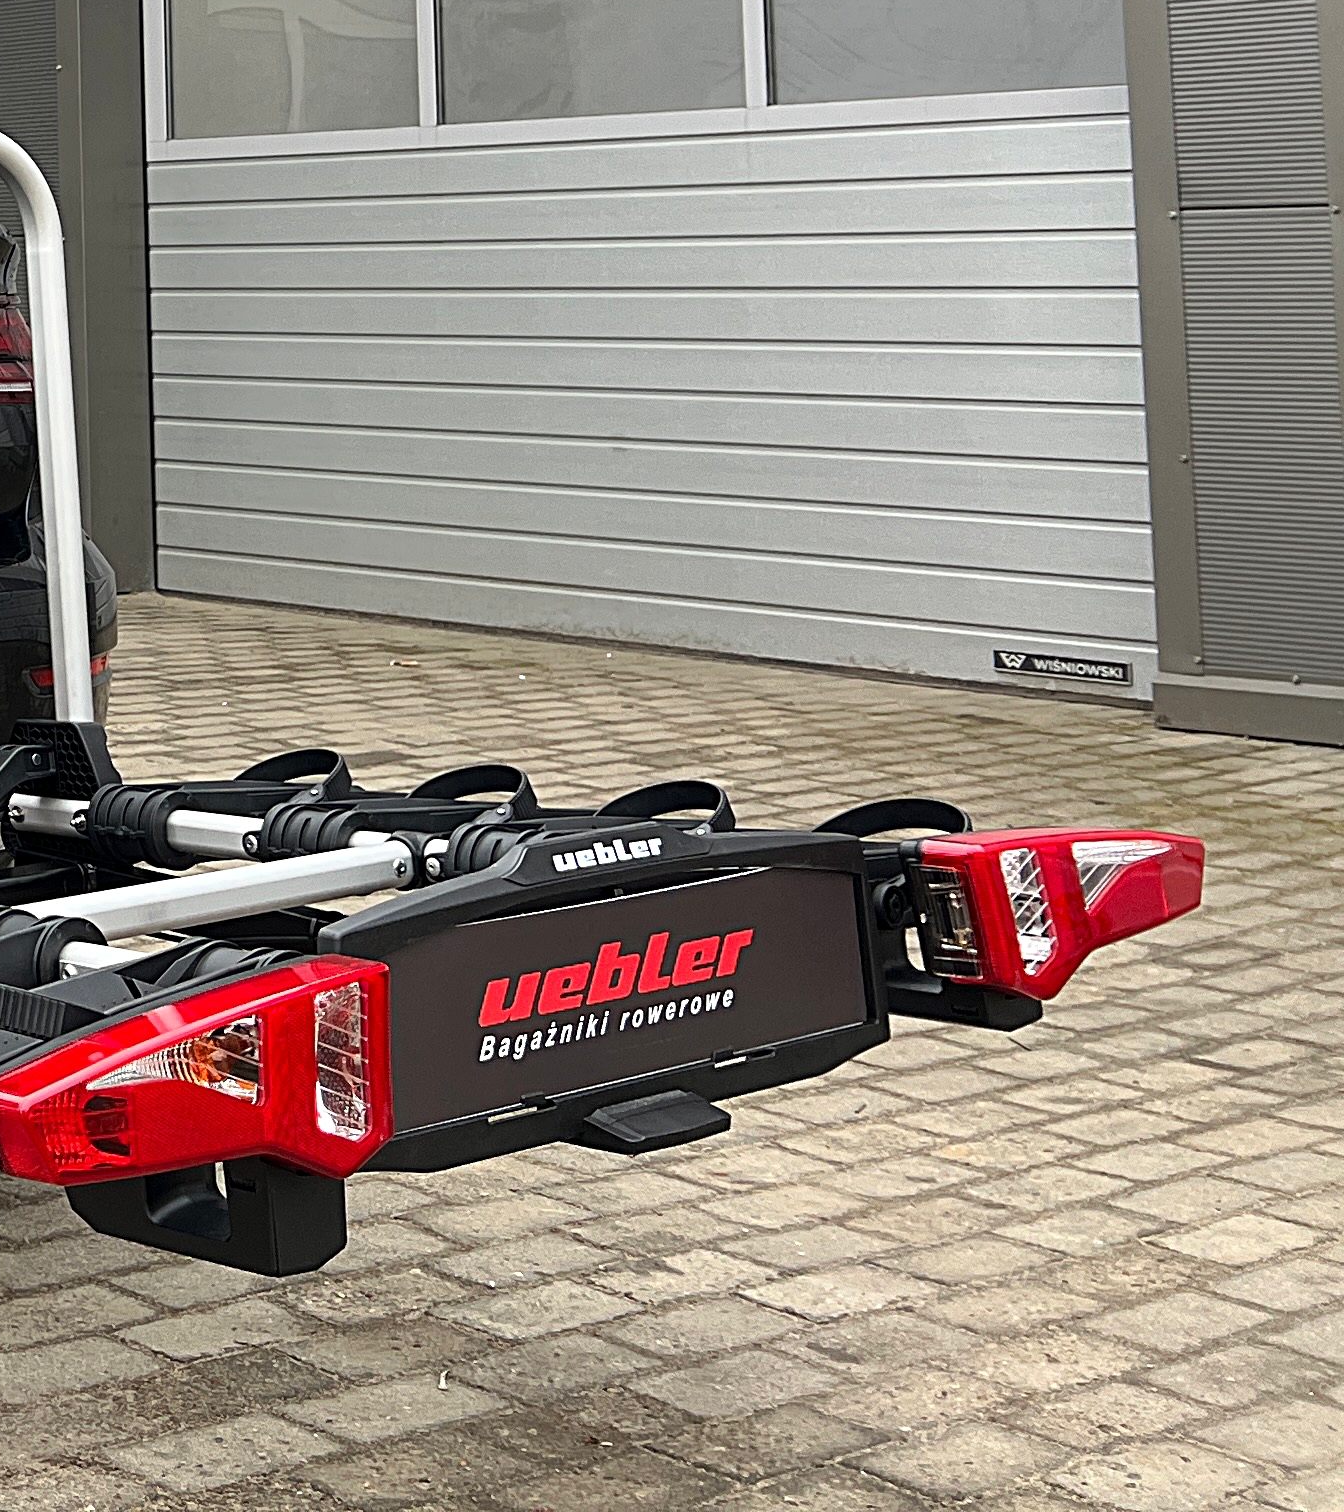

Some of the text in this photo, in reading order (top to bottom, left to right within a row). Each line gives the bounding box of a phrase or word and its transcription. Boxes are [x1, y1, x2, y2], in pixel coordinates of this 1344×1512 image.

[1032, 658, 1124, 679] WIŚNIOWSKI
[479, 988, 735, 1063] Bagażniki rowerowe
